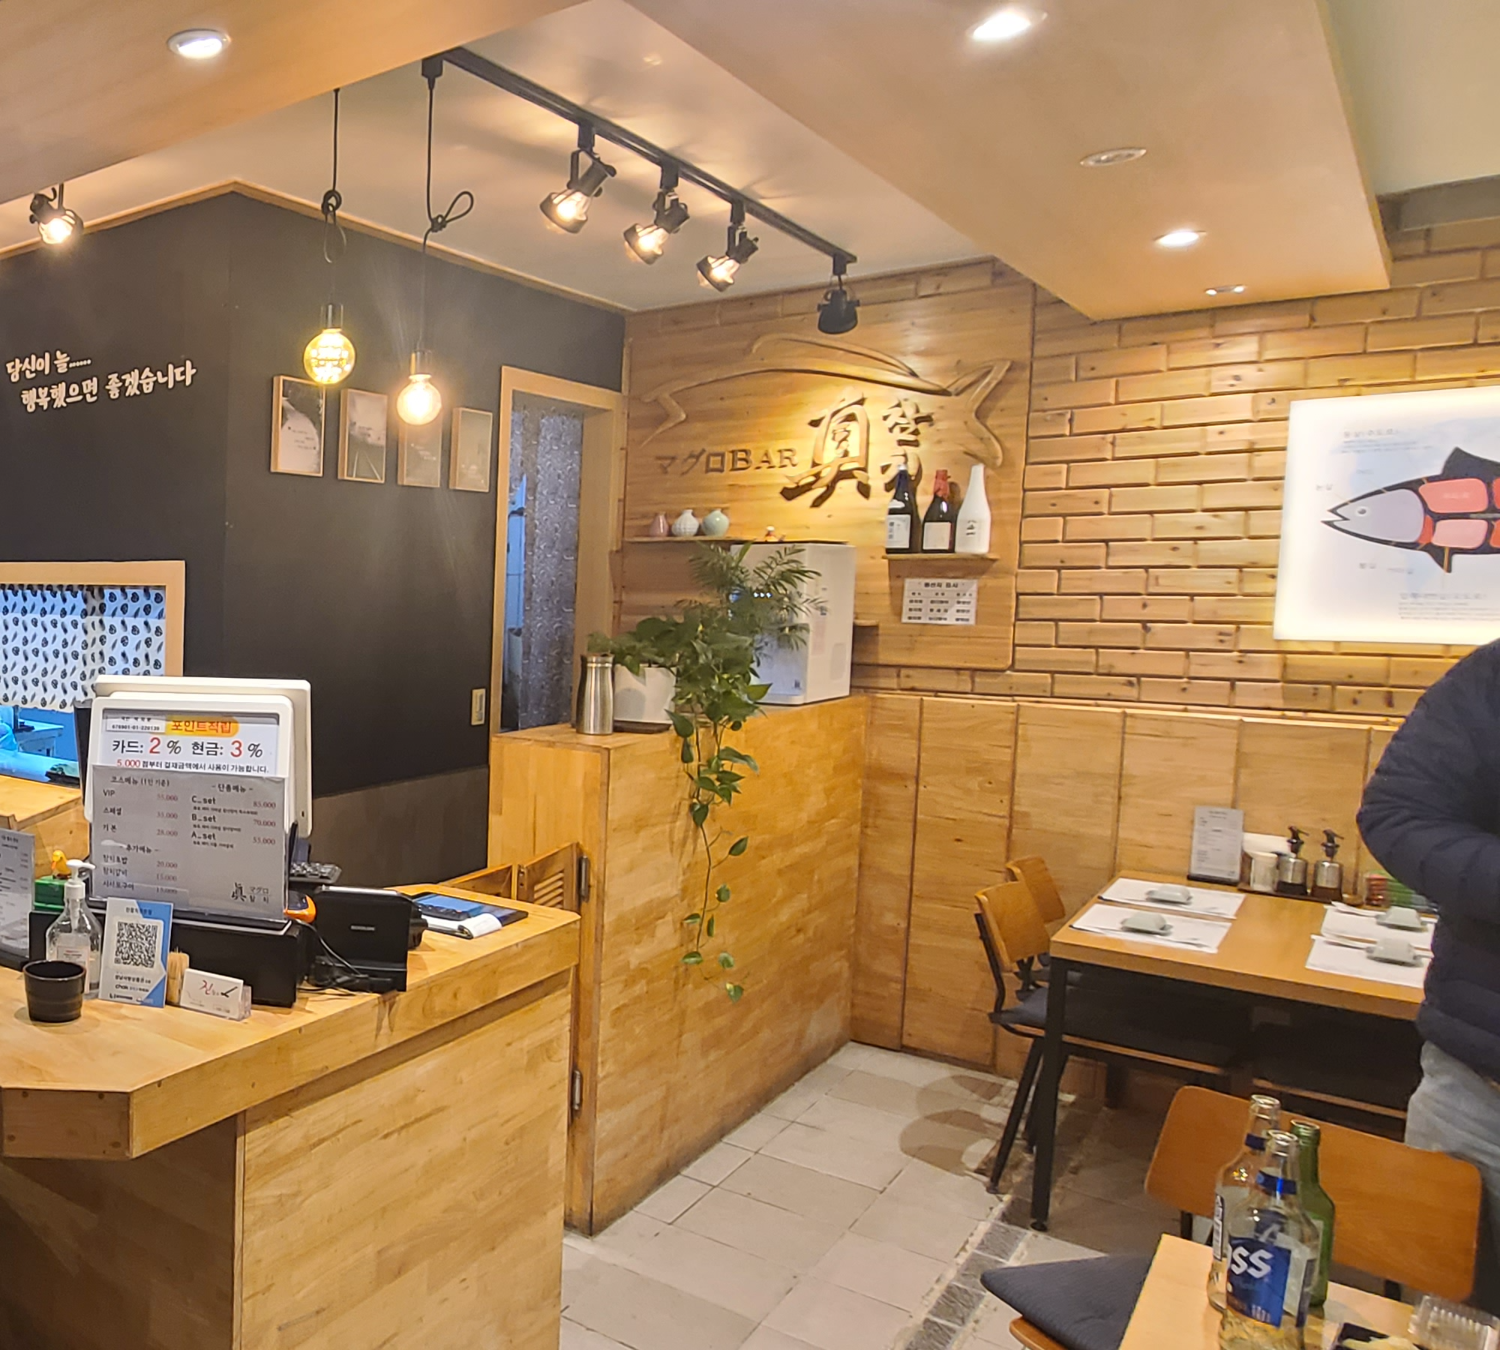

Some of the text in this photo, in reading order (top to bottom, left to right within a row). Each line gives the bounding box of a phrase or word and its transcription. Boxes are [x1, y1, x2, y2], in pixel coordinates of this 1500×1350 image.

[5, 352, 50, 382] 당신이
[21, 360, 197, 412] 행복했으면 좋겠습니다
[171, 719, 232, 734] 포인트적립
[112, 737, 263, 758] 카드: 2 % 현금: 3 %
[110, 776, 138, 785] 코스메뉴
[102, 789, 116, 797] VIP
[103, 807, 122, 816] 스페셜
